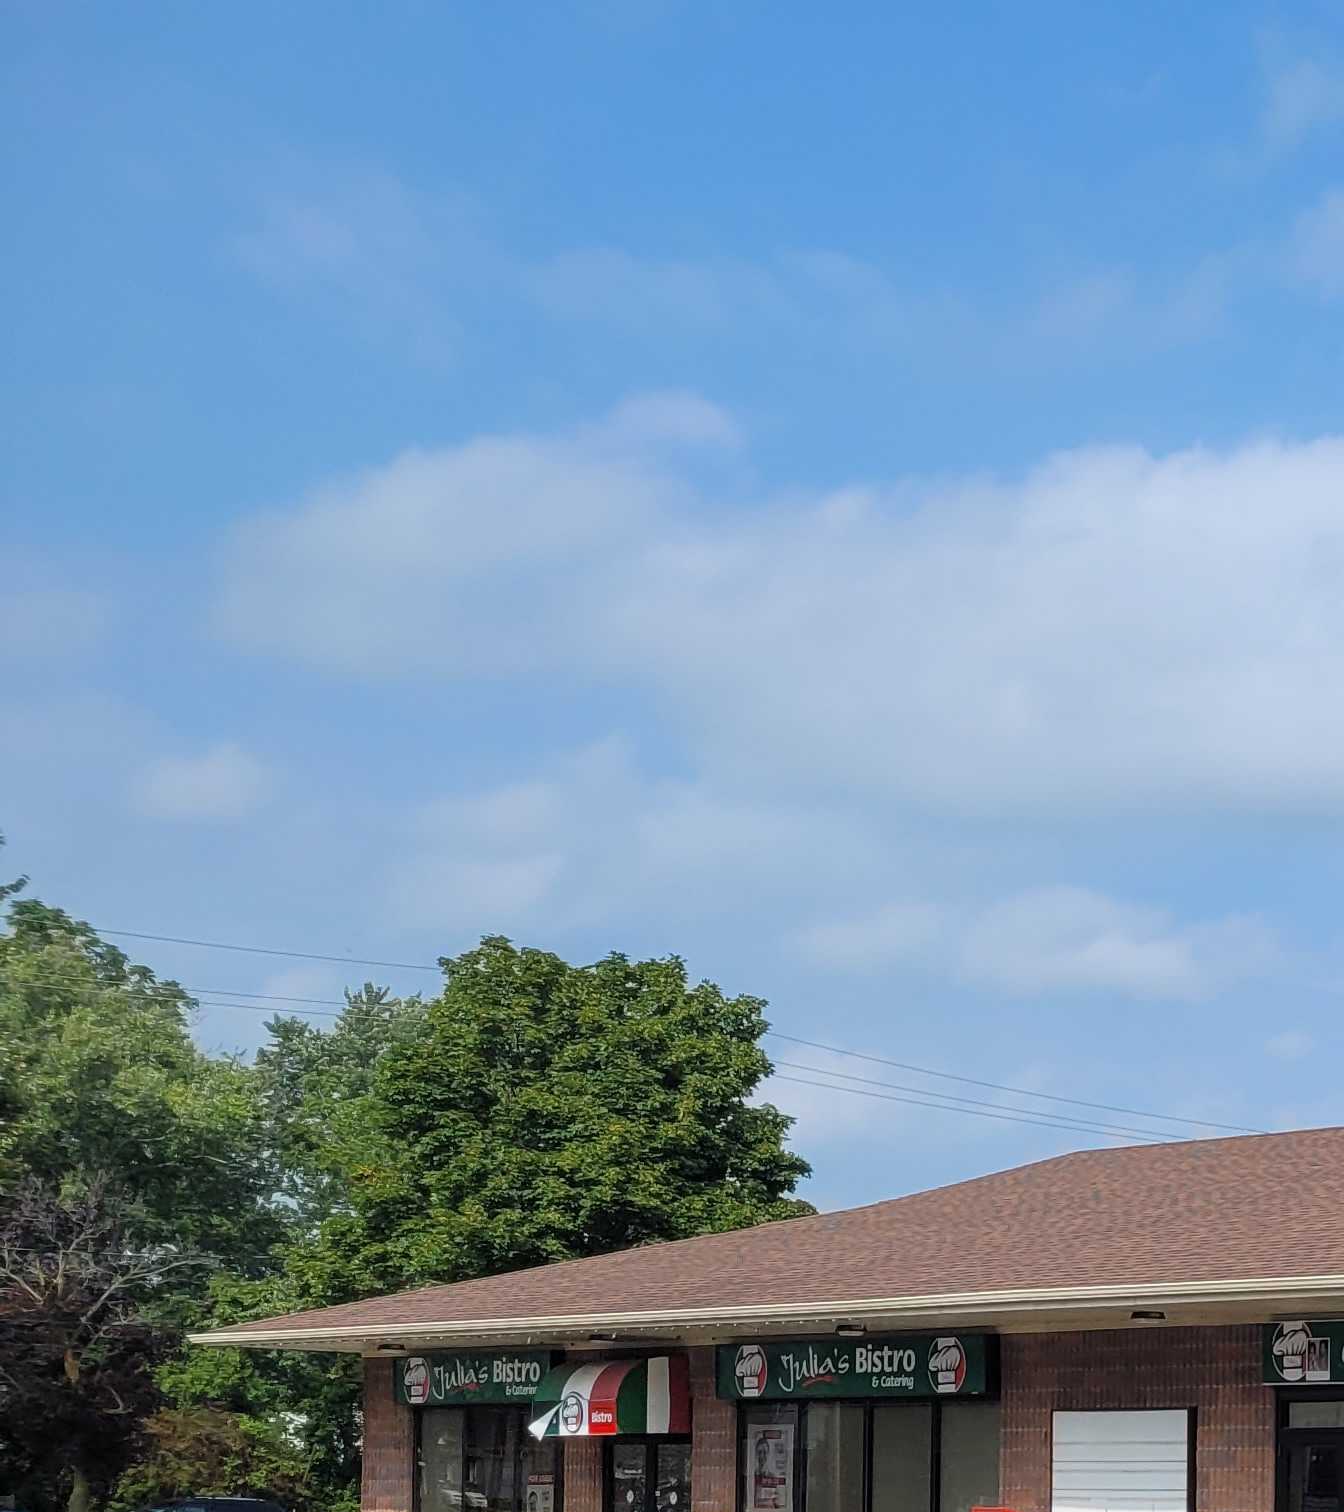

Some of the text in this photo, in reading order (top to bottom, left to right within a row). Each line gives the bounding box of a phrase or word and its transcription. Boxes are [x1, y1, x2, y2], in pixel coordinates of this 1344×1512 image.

[432, 1357, 540, 1399] Julia's Bistro
[778, 1343, 916, 1392] Julia's Bistro
[872, 1374, 914, 1390] & Catering
[591, 1411, 613, 1424] Bistro
